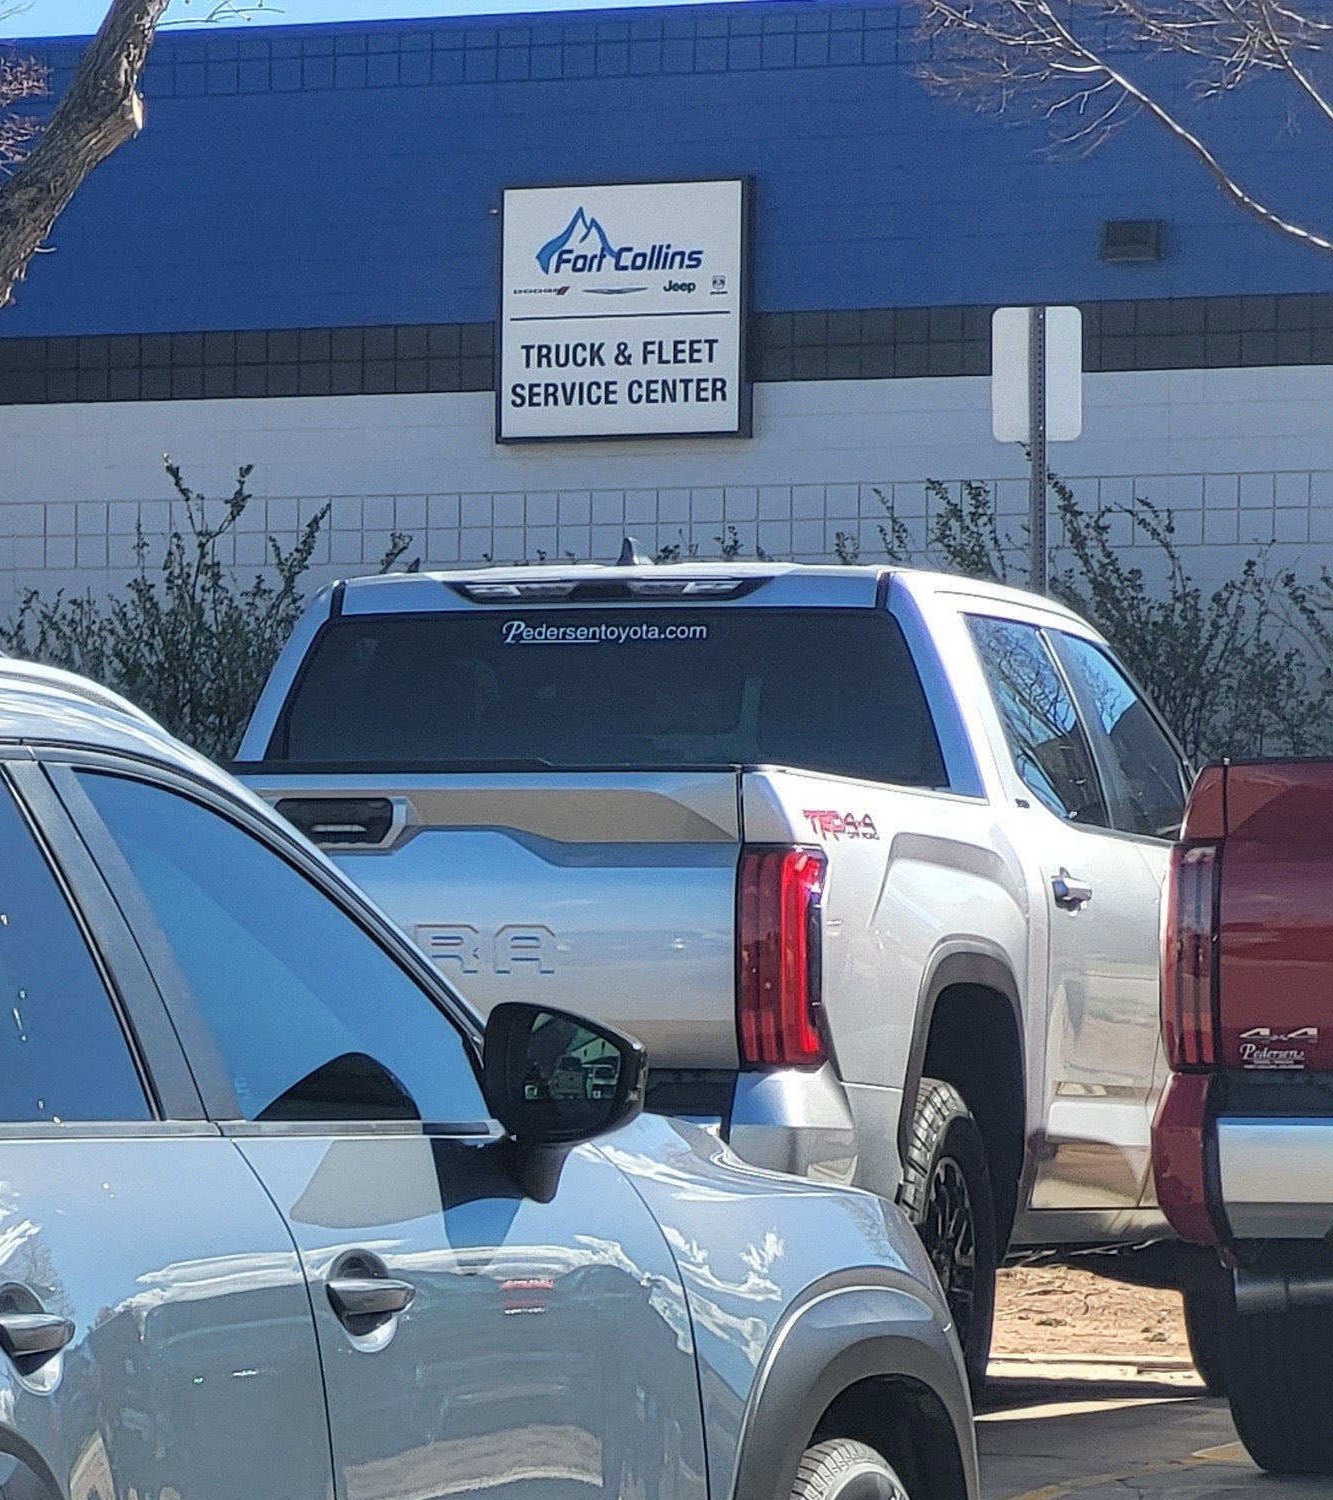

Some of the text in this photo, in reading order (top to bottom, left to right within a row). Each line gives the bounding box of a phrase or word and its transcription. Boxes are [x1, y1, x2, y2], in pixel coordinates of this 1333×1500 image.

[554, 244, 704, 275] Fort Collins
[663, 279, 696, 294] Jeep
[521, 338, 719, 369] TRUCK & FLEET
[511, 377, 727, 408] SERVICE CENTER
[502, 620, 708, 644] Pedersentoyota.com
